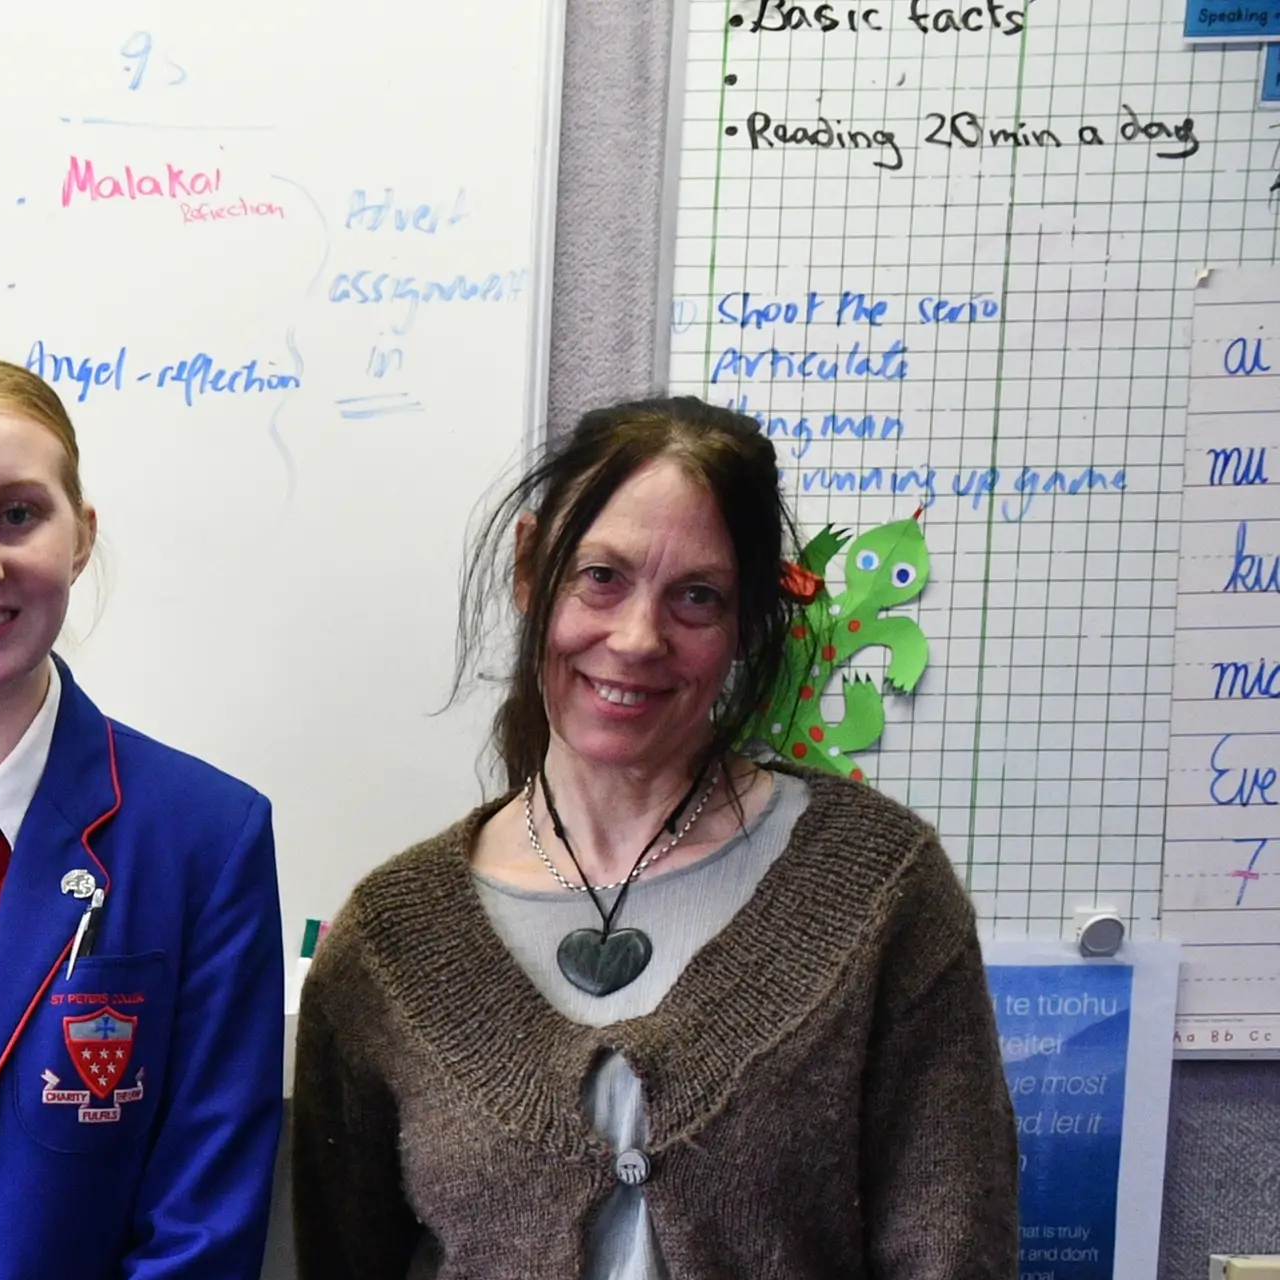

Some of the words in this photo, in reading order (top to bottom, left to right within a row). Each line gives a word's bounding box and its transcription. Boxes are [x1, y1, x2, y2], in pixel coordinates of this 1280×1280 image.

[750, 0, 883, 33] Basic
[1199, 8, 1268, 27] Speaking
[747, 110, 903, 170] Reading
[1078, 128, 1102, 147] a
[1122, 104, 1200, 159] day
[718, 291, 824, 329] Shoot
[837, 291, 888, 327] the
[952, 466, 1000, 510] up
[1006, 994, 1031, 1016] te
[1042, 1074, 1108, 1095] most
[45, 1092, 88, 1103] CHARITY
[1050, 1112, 1081, 1134] let
[1086, 1112, 1103, 1134] it
[1042, 1225, 1056, 1239] is
[1057, 1224, 1091, 1241] truly
[1028, 1246, 1058, 1261] and
